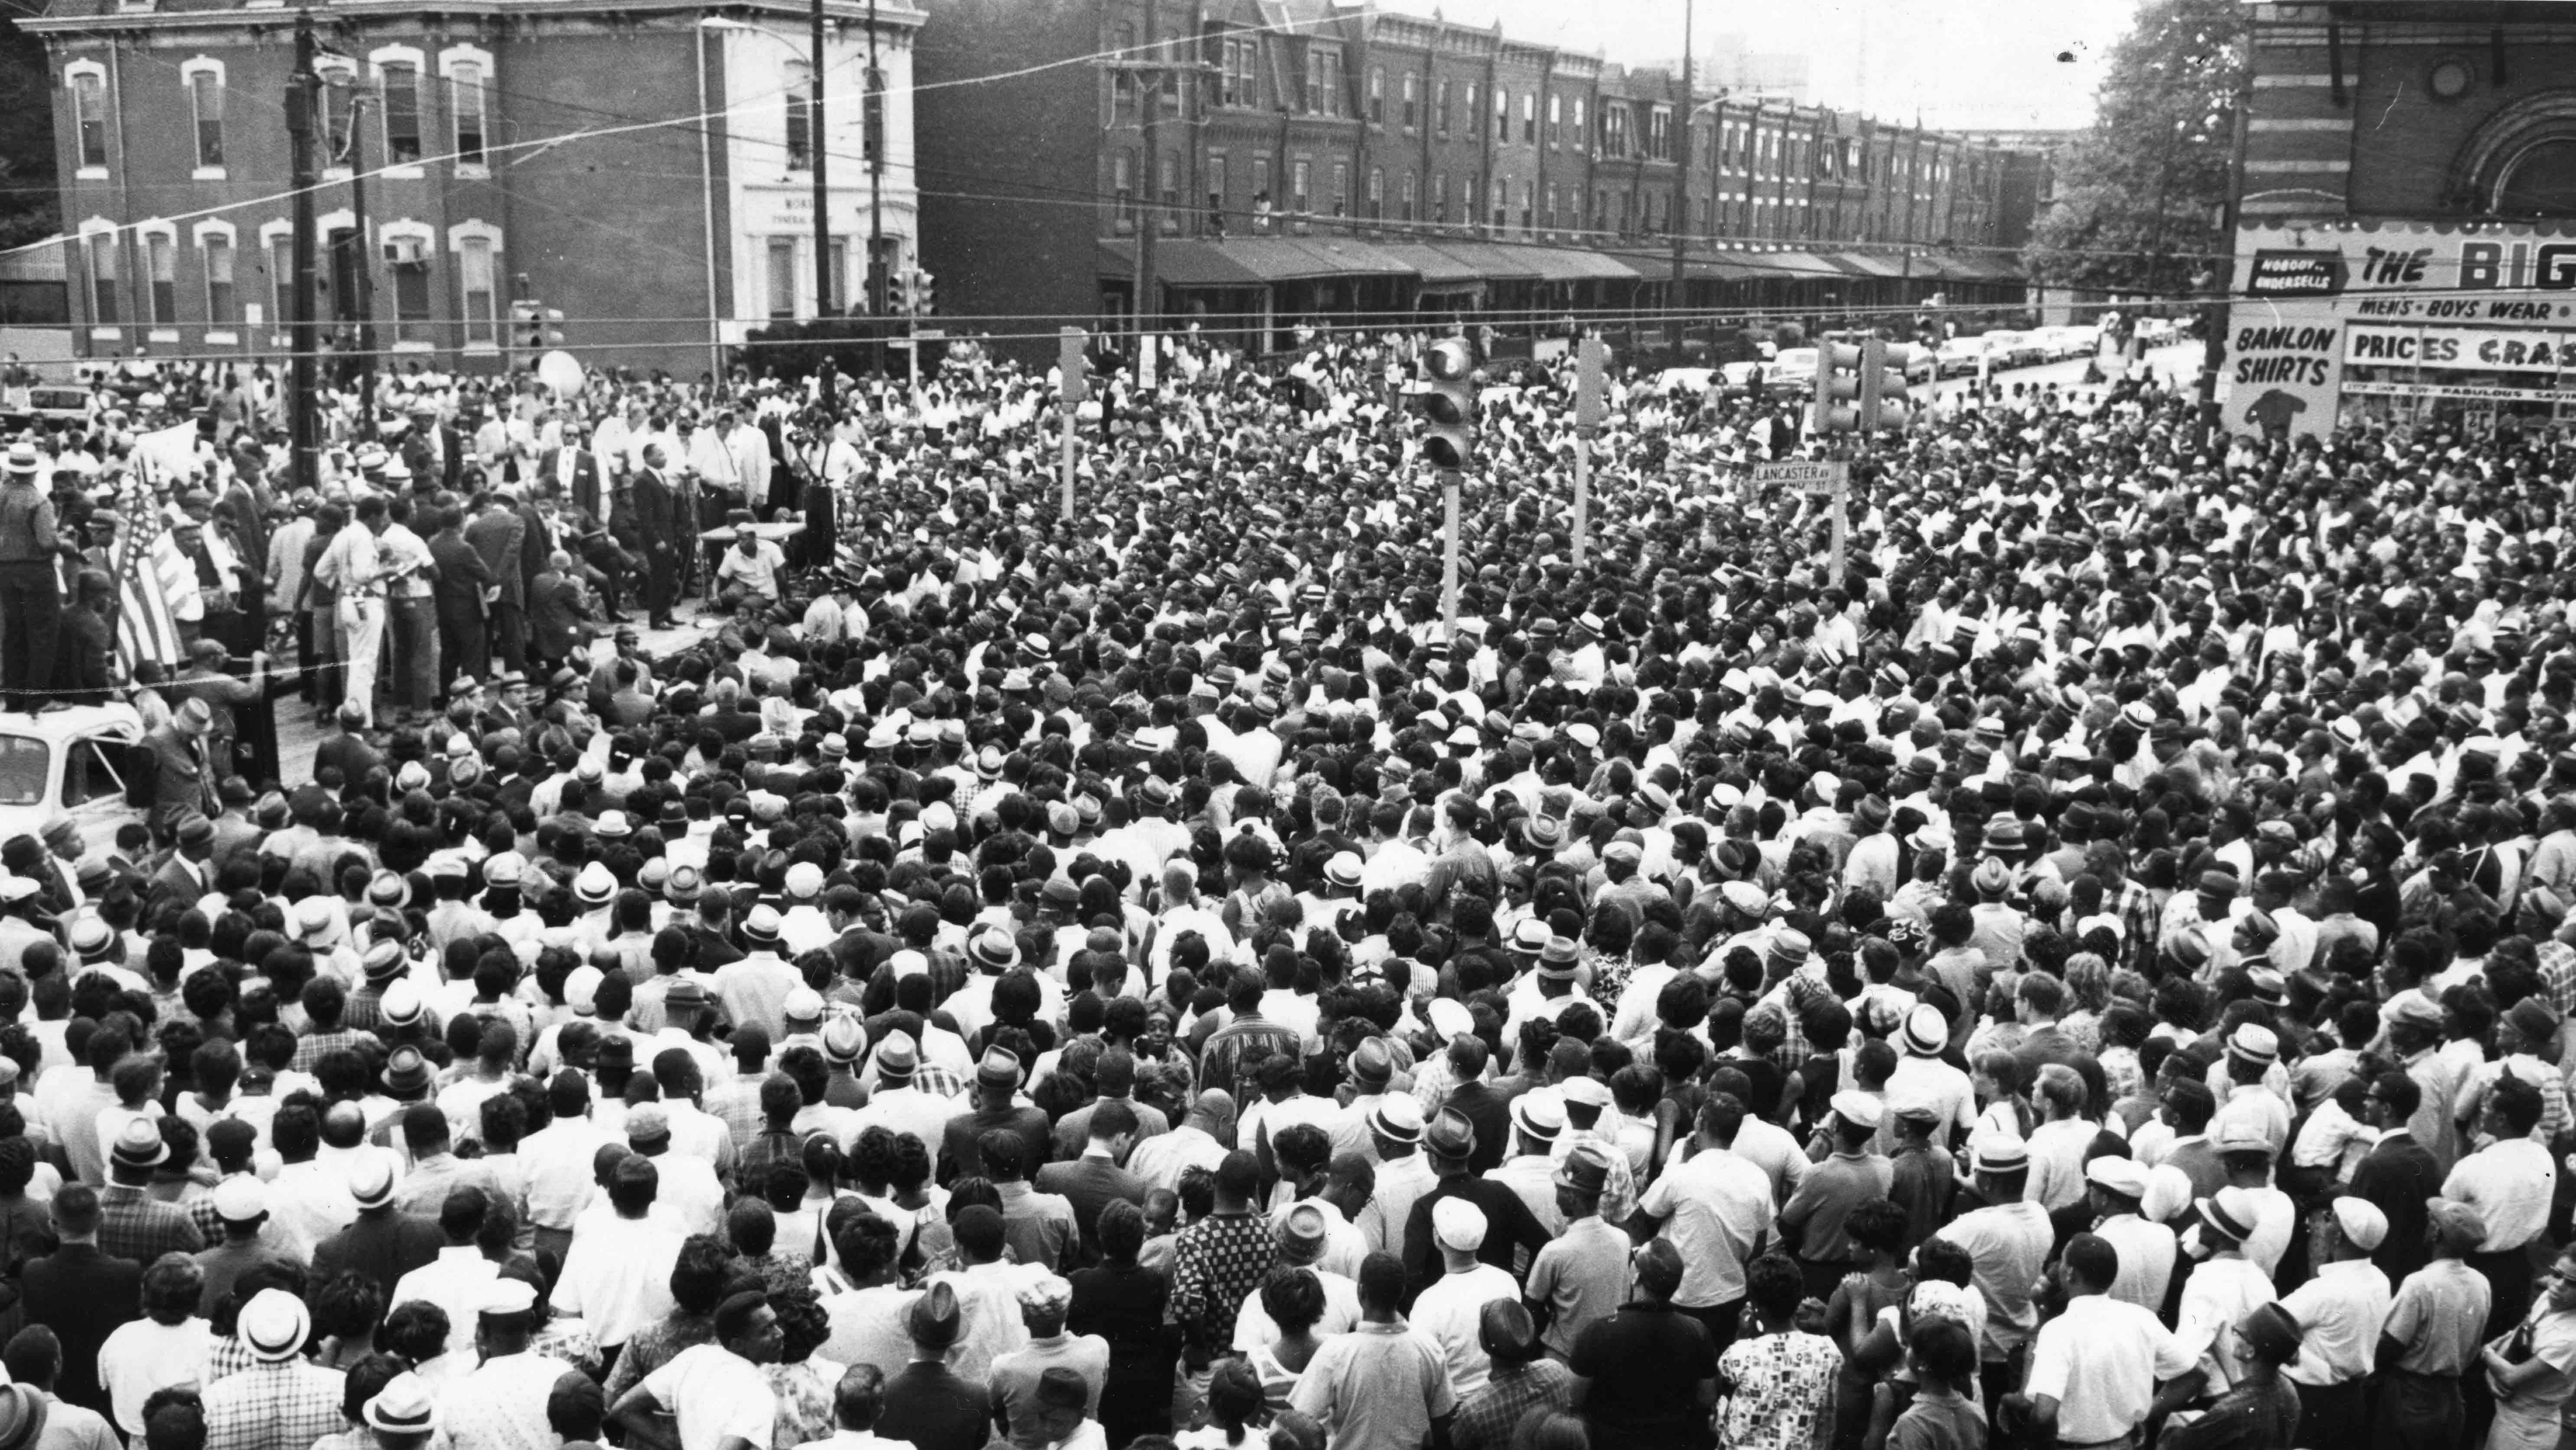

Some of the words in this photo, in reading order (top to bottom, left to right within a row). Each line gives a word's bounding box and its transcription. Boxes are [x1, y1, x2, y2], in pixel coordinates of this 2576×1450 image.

[2363, 246, 2433, 283] THE
[2459, 241, 2576, 290] BIG
[2255, 275, 2330, 290] UNDERSELLS
[2426, 300, 2480, 317] BOYS
[2488, 302, 2552, 319] WEAR
[2236, 327, 2336, 352] BANLON
[2353, 335, 2459, 361] PRICES
[2235, 356, 2329, 386] SHIRTS
[2442, 388, 2522, 398] FABULOUS
[1756, 466, 1817, 481] LANCASTER
